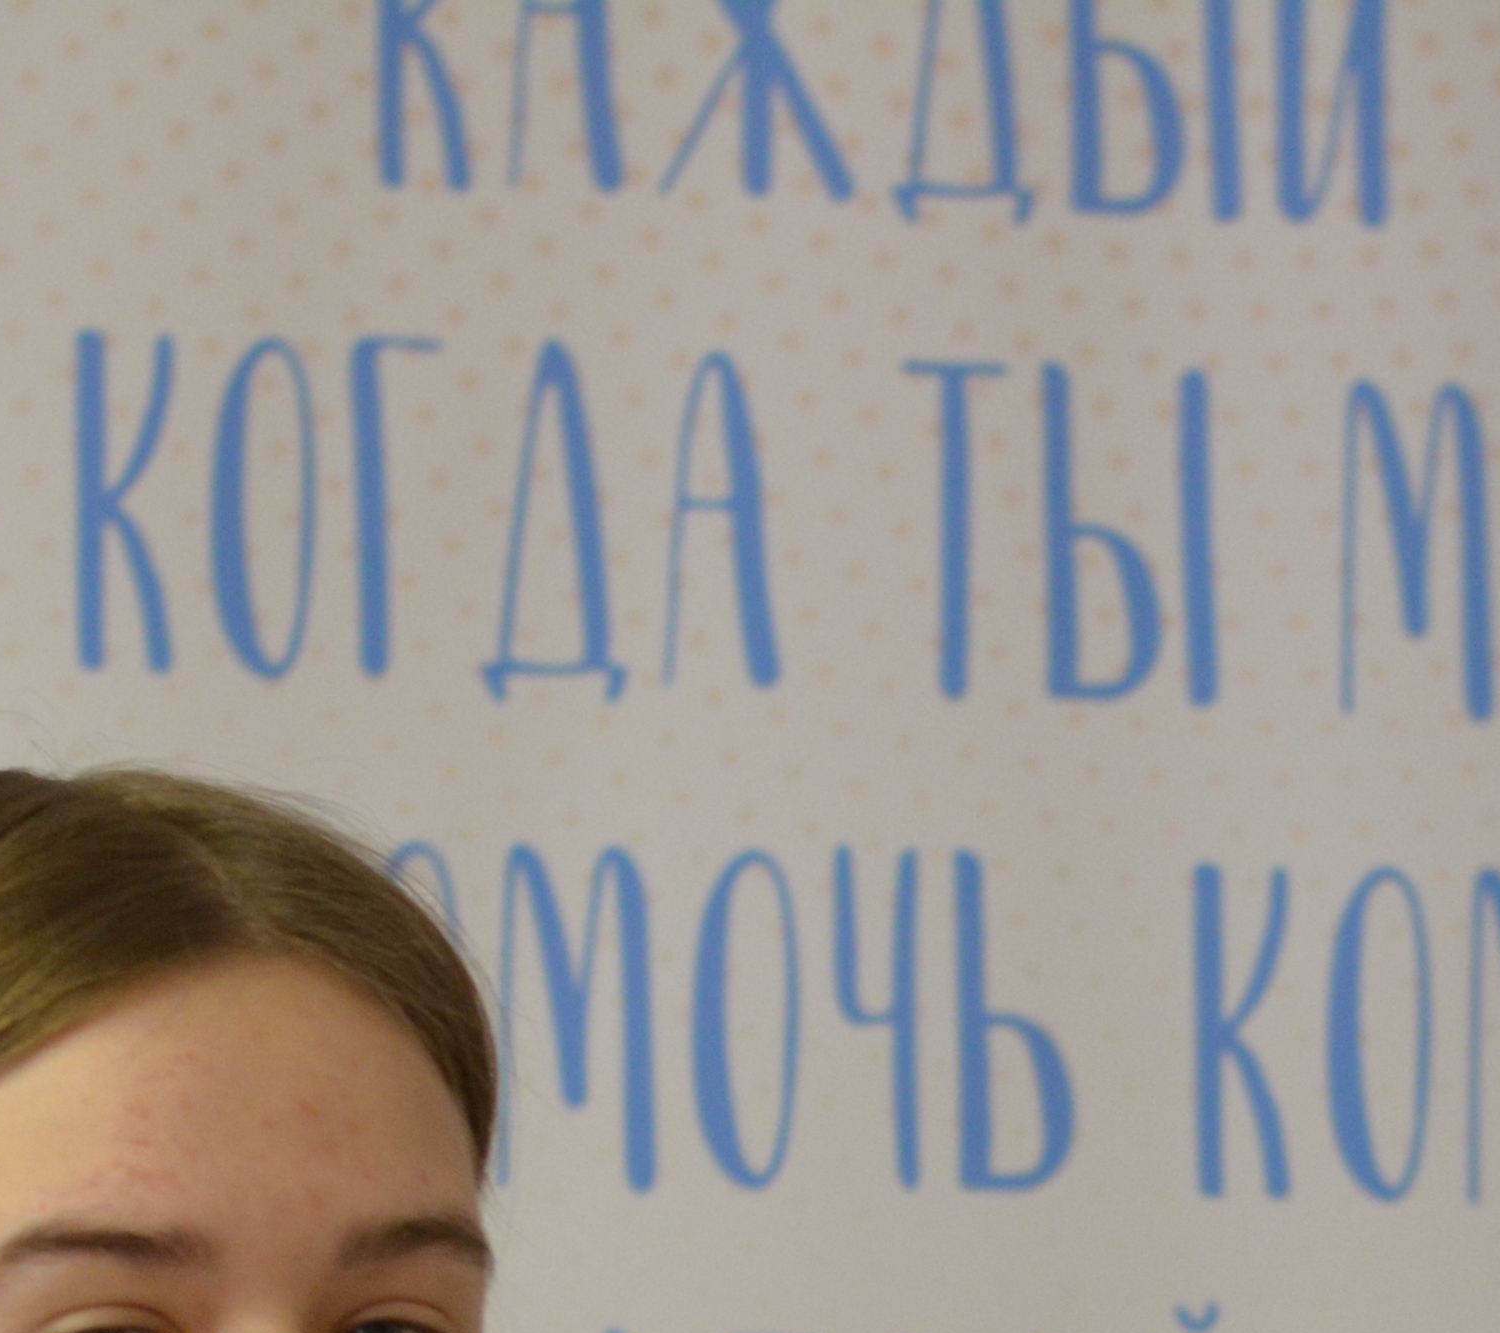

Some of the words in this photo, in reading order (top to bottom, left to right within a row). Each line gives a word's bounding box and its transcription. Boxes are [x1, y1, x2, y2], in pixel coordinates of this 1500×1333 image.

[72, 328, 784, 701] КОГДА
[902, 358, 1220, 709] ТЫ
[386, 840, 1078, 1196] МОЧЬ
